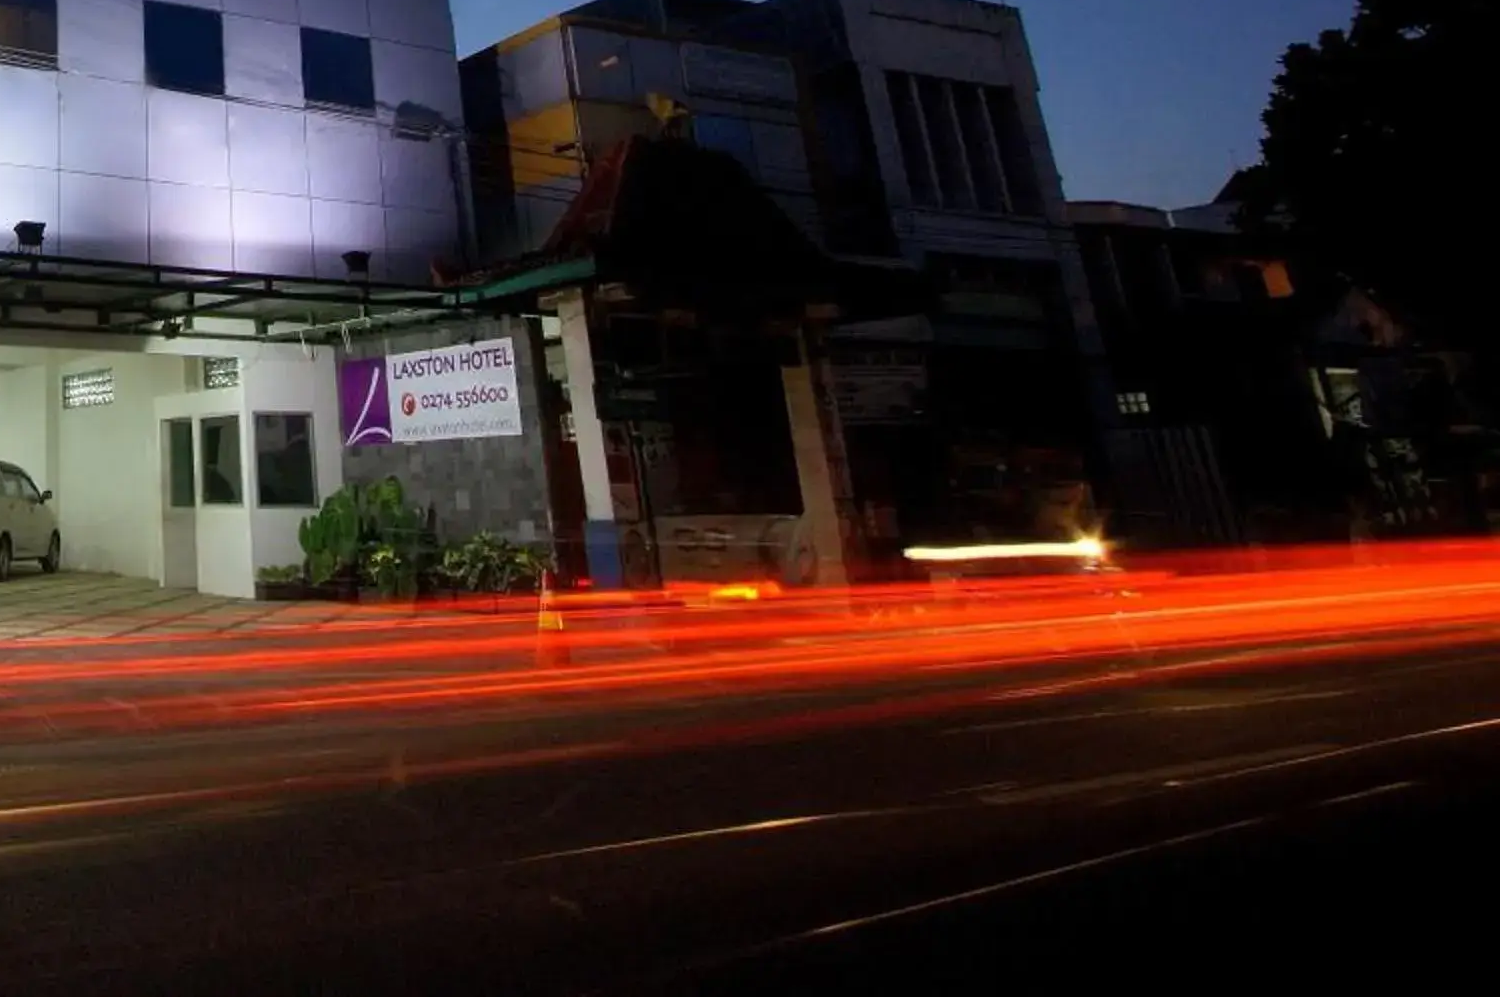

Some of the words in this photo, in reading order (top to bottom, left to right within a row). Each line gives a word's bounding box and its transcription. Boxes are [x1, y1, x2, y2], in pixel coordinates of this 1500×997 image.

[393, 356, 454, 379] LAXSTON
[459, 347, 512, 371] HOTEL
[421, 392, 453, 411] 0274
[455, 385, 508, 408] 556600
